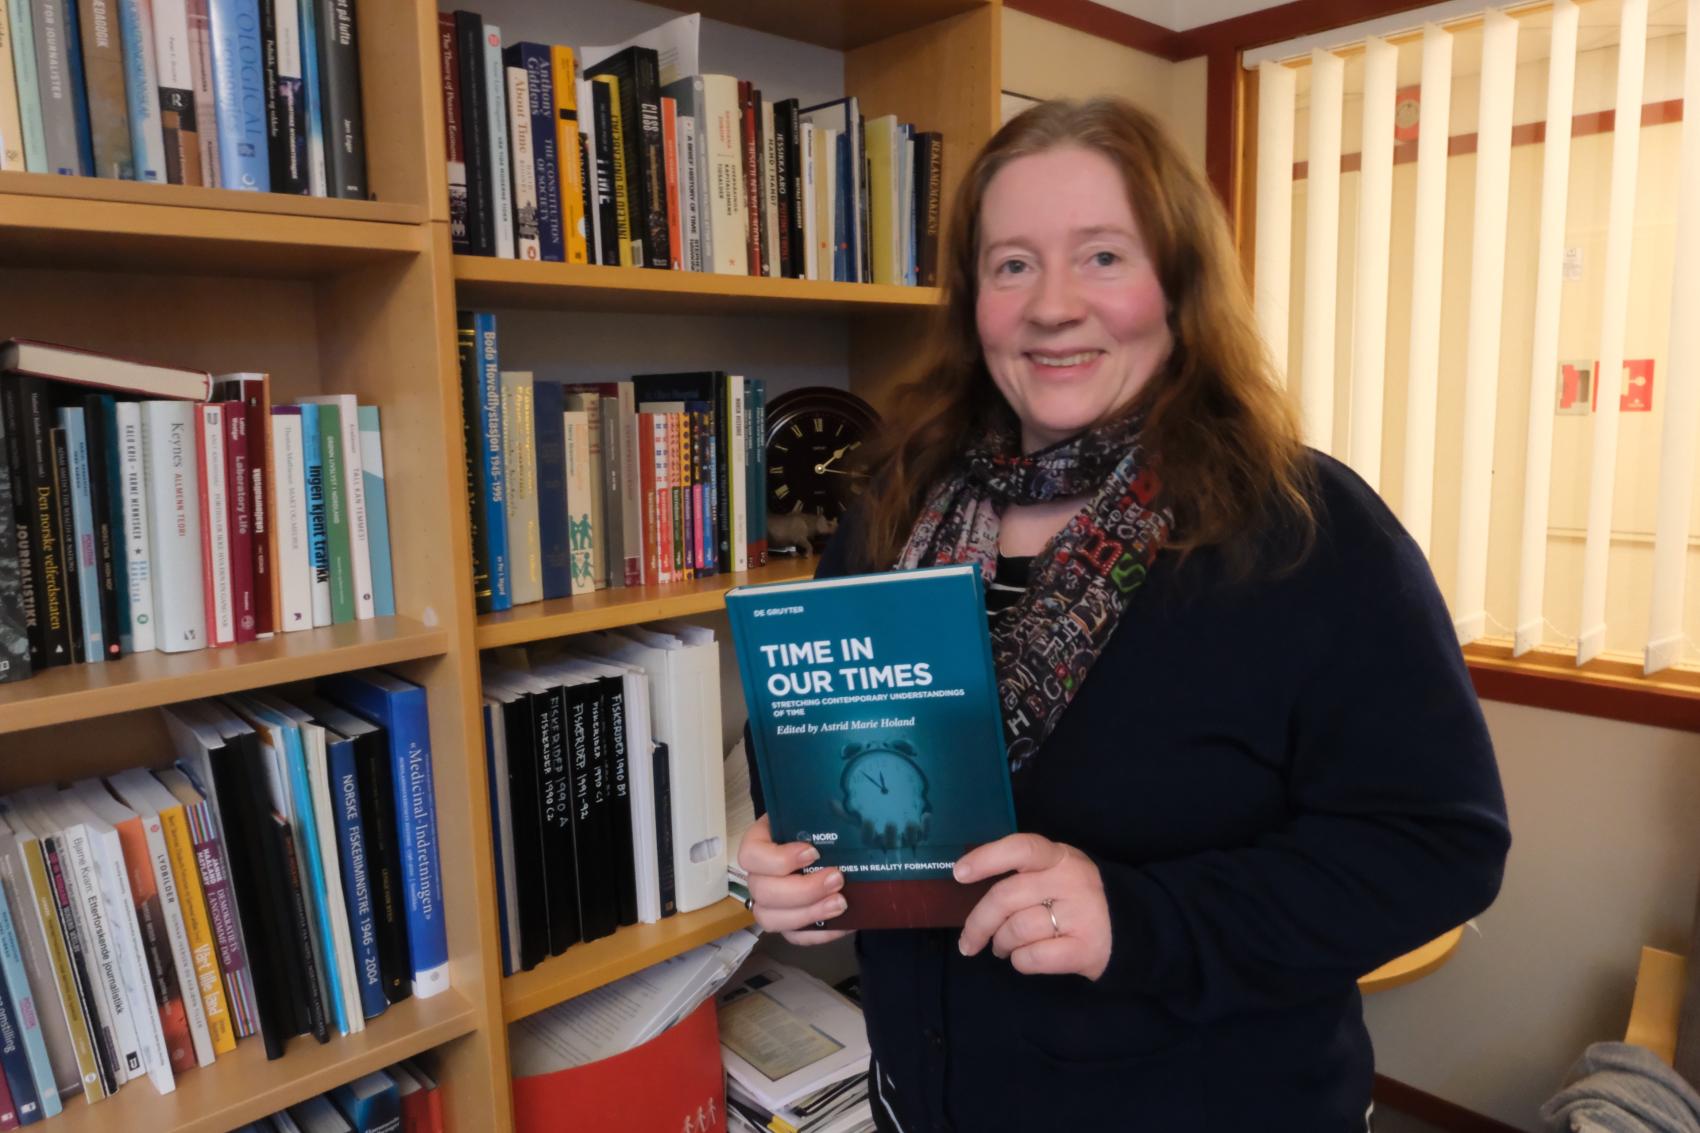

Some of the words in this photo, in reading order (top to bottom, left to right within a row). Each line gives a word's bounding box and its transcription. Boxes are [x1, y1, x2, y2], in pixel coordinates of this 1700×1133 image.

[340, 22, 351, 46] lufta
[515, 78, 528, 118] About
[527, 57, 540, 116] Giddens
[539, 58, 552, 118] Anthony
[641, 103, 658, 132] CLASS
[517, 122, 530, 154] Time
[544, 138, 554, 160] THE
[776, 134, 786, 174] JESSIKKA
[537, 158, 546, 171] OF
[538, 174, 549, 220] SOCIETY
[546, 162, 558, 244] CONSTITUTION
[690, 202, 696, 212] OF
[484, 331, 497, 360] Bodø
[483, 364, 500, 452] Hovedflystasjon
[126, 424, 135, 443] KALD
[168, 422, 184, 468] Keynes
[127, 445, 136, 462] KRIG
[36, 486, 50, 510] Den
[128, 472, 138, 495] VARME
[174, 474, 184, 511] ALLMENN
[235, 456, 246, 512] Laboratory
[308, 464, 322, 500] Ingen
[252, 468, 264, 533] Lokaljournalistikk
[40, 514, 54, 552] norske
[130, 498, 142, 540] MENNESKER
[176, 514, 186, 536] TEORI
[238, 514, 248, 534] Life
[309, 504, 326, 536] kjent
[16, 524, 36, 628] JOURNALISTIKK
[314, 540, 330, 584] trafikk
[43, 554, 61, 630] velferdsstaten
[753, 609, 766, 618] DE
[766, 606, 804, 616] GRUYTER
[760, 640, 834, 668] TIME
[840, 636, 874, 662] IN
[767, 670, 834, 696] OUR
[838, 662, 934, 690] TIMES
[771, 698, 821, 709] STRETCHING
[822, 693, 889, 706] CONTEMPORARY
[890, 688, 965, 700] UNDERSTANDINGS
[773, 710, 784, 718] OF
[786, 708, 806, 716] TIME
[776, 724, 806, 735] Edited
[807, 724, 818, 734] by
[820, 720, 849, 732] Astrid
[850, 720, 879, 730] Marie
[880, 716, 916, 728] Holand
[616, 758, 626, 782] 1990
[342, 774, 358, 820] NORSKE
[544, 780, 554, 806] 1990
[554, 777, 567, 812] 1990
[408, 742, 434, 920] «Medicinal-Indretningen»
[558, 816, 568, 828] A
[812, 832, 838, 841] NORD
[157, 854, 174, 904] LYDBILDER
[203, 848, 216, 884] HAALAND
[348, 826, 370, 916] FISKERIMINISTRE
[870, 864, 902, 872] REALITY
[207, 892, 226, 944] LANGSOMME
[216, 888, 237, 952] DEMOKRATIETS
[361, 918, 374, 945] 1946
[86, 895, 110, 960] Etterforskende
[102, 961, 124, 1016] journalistikk
[365, 958, 378, 984] 2004
[0, 1008, 16, 1054] omstilling
